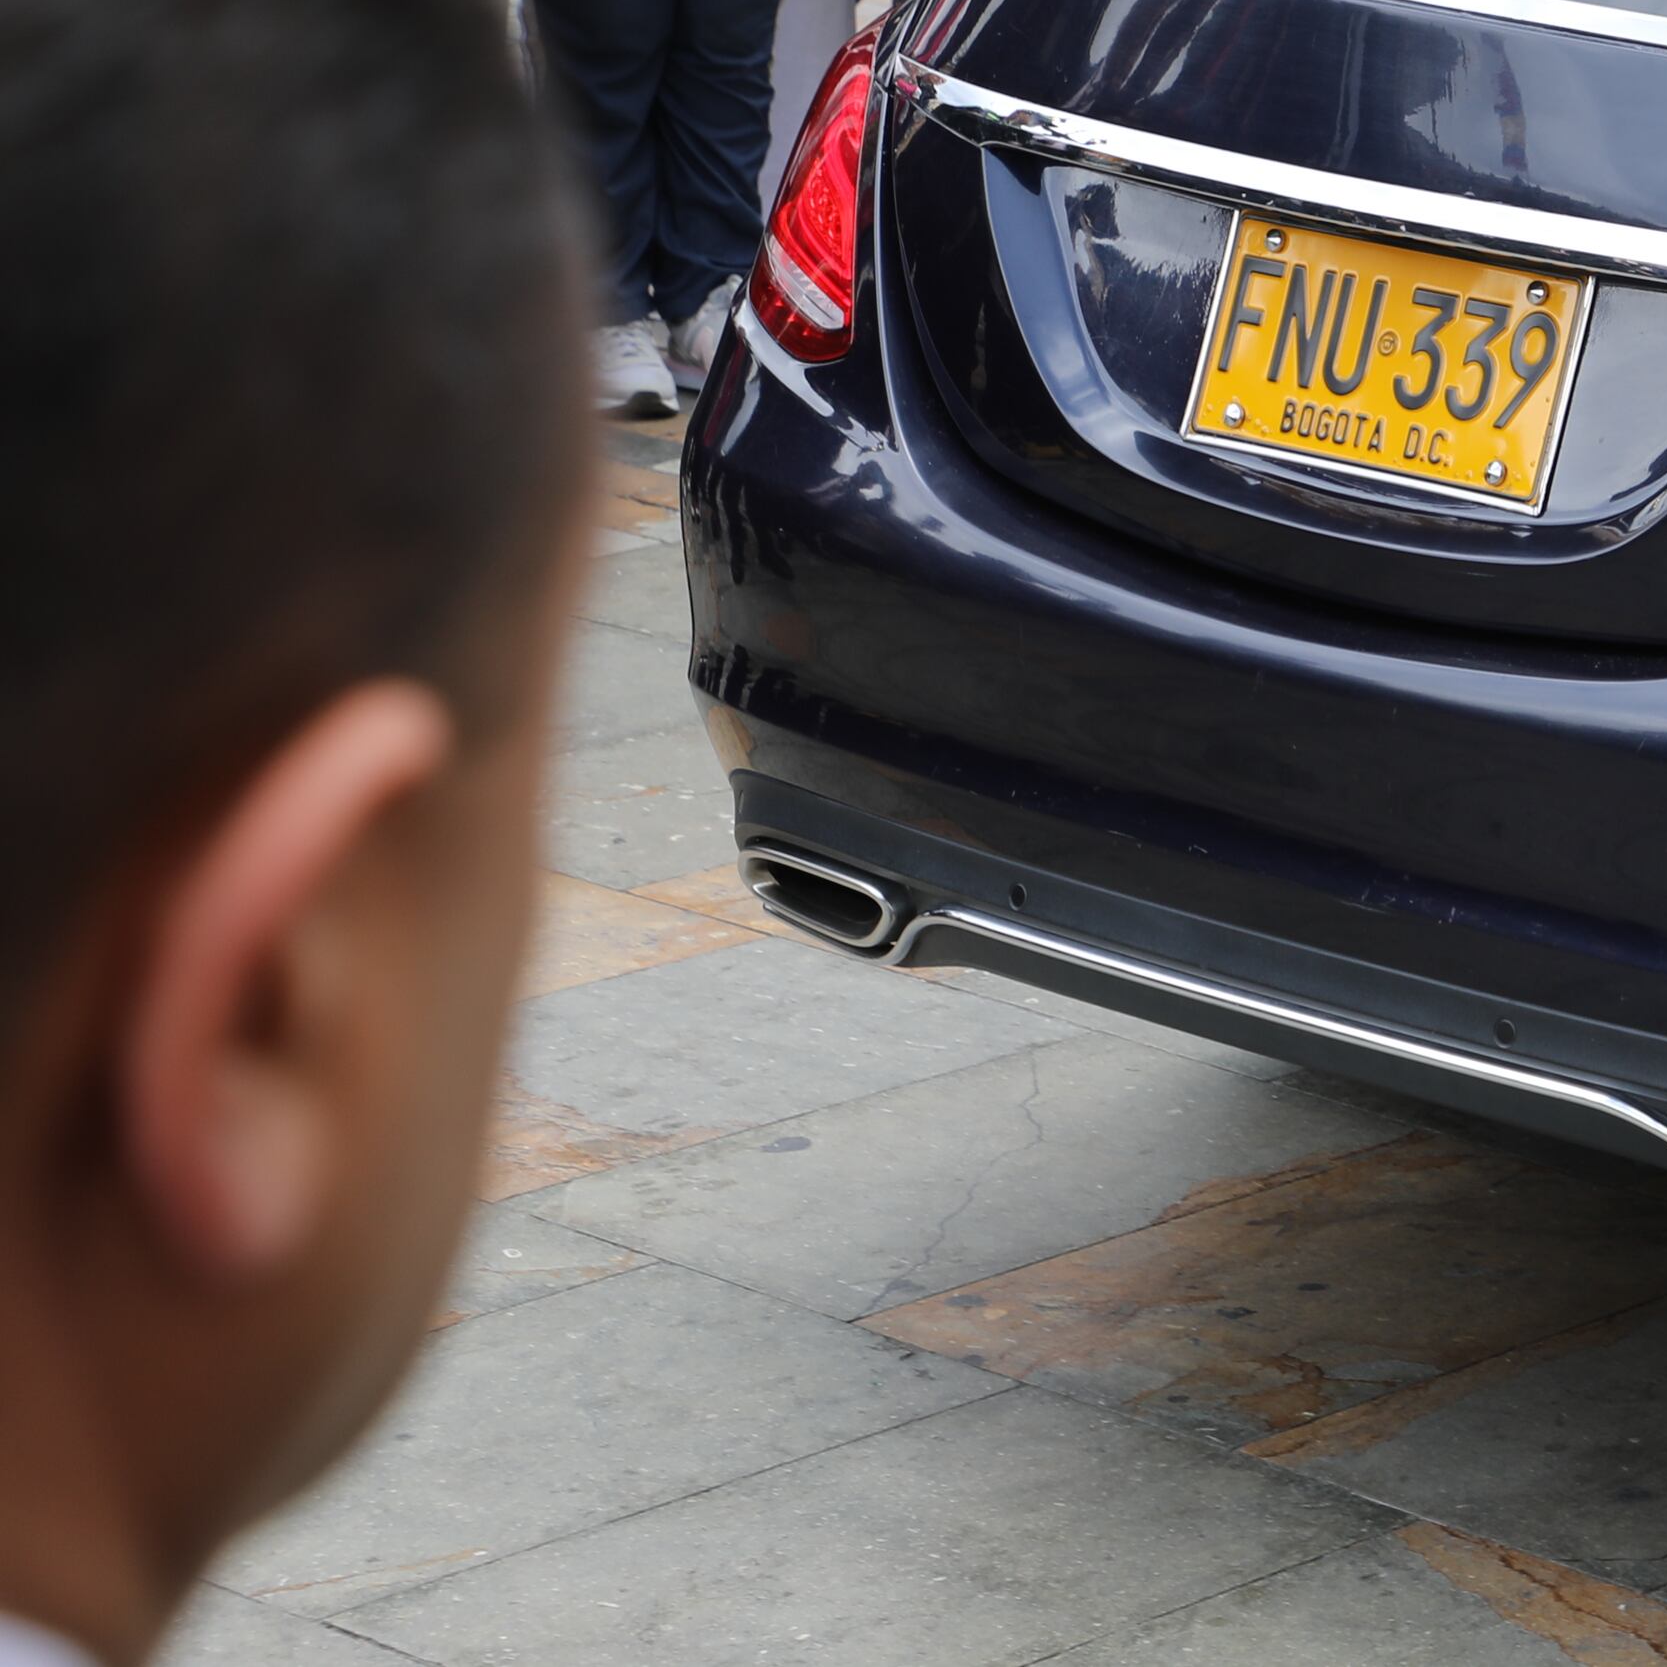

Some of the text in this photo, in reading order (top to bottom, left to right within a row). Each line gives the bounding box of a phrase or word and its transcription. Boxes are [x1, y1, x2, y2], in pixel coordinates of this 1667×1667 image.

[1217, 254, 1560, 430] FNU 339
[1280, 399, 1450, 468] BOGOTA D.C.
